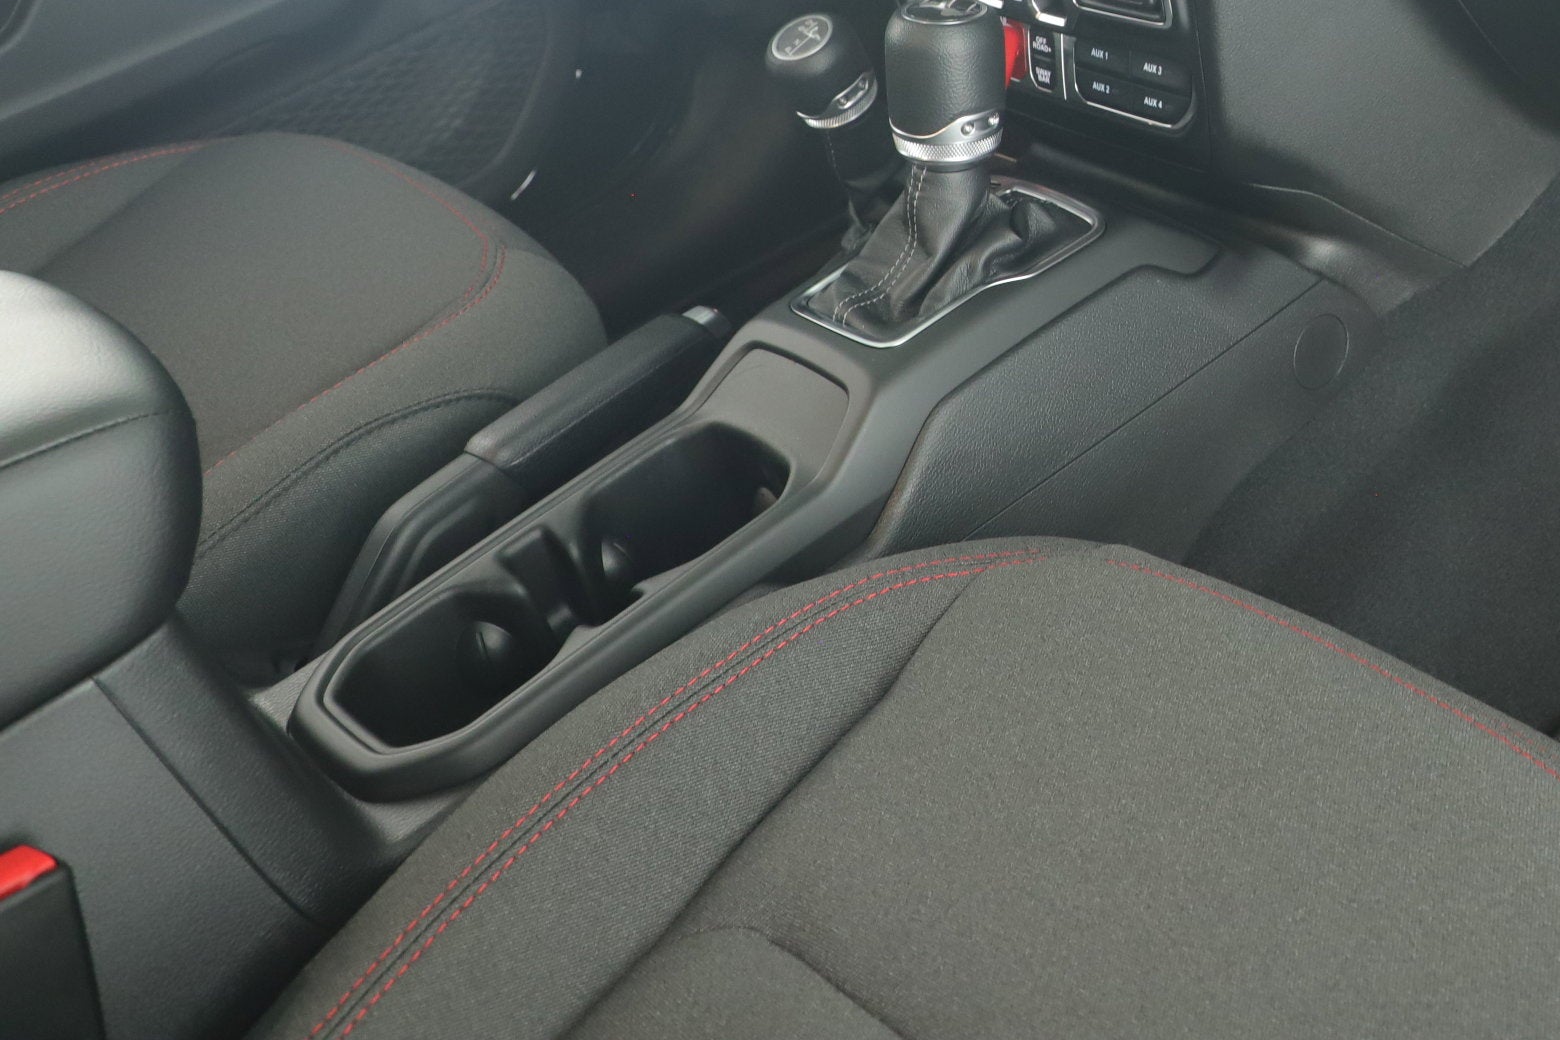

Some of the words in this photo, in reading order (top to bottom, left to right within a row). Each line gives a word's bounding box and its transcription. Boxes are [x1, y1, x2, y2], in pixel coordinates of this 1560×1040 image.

[1035, 35, 1047, 45] OFF
[1091, 48, 1104, 59] AUX
[1035, 66, 1052, 78] SWAY
[1142, 63, 1156, 74] AUX
[1157, 67, 1163, 76] 3
[1038, 73, 1050, 85] BAR
[1092, 81, 1105, 92] AUX
[1143, 96, 1157, 108] AUX
[1157, 100, 1163, 109] 4
